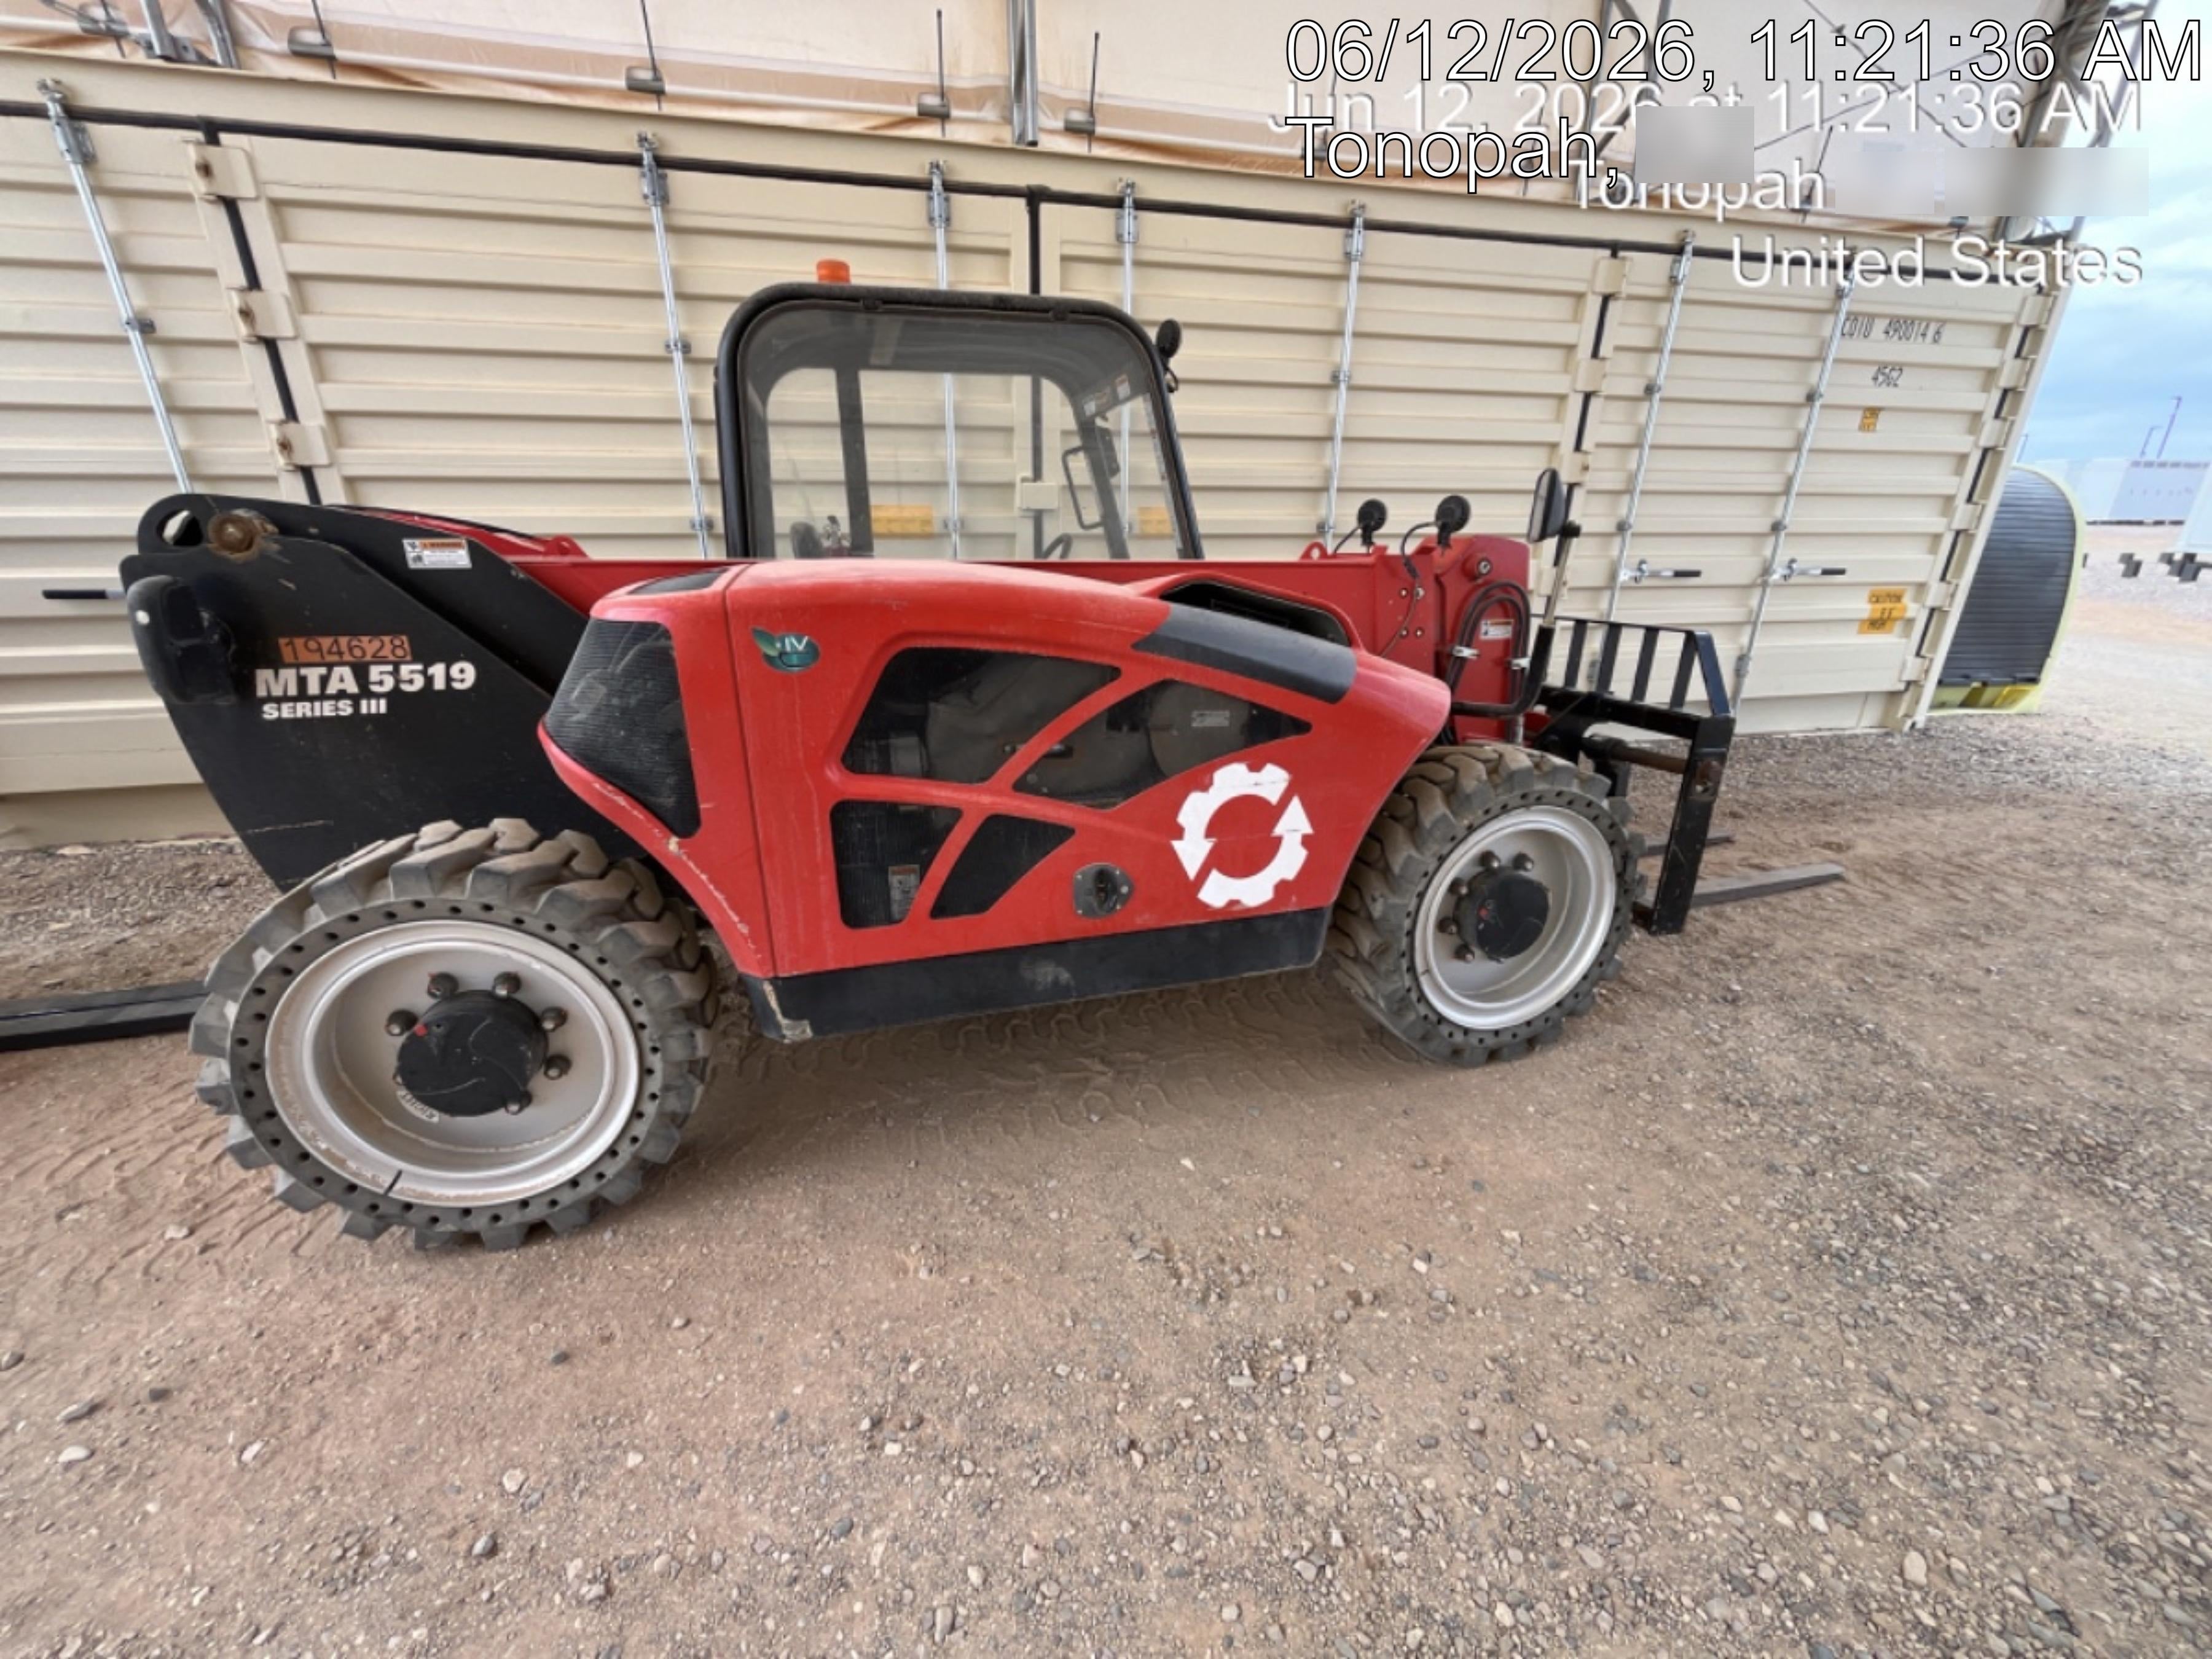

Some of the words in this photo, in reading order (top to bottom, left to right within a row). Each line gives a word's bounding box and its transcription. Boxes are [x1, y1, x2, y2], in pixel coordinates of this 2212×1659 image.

[284, 637, 409, 661] 194628
[255, 665, 360, 697] MTA
[369, 661, 477, 693] 5519
[261, 699, 355, 720] SERIES
[359, 698, 387, 715] III
